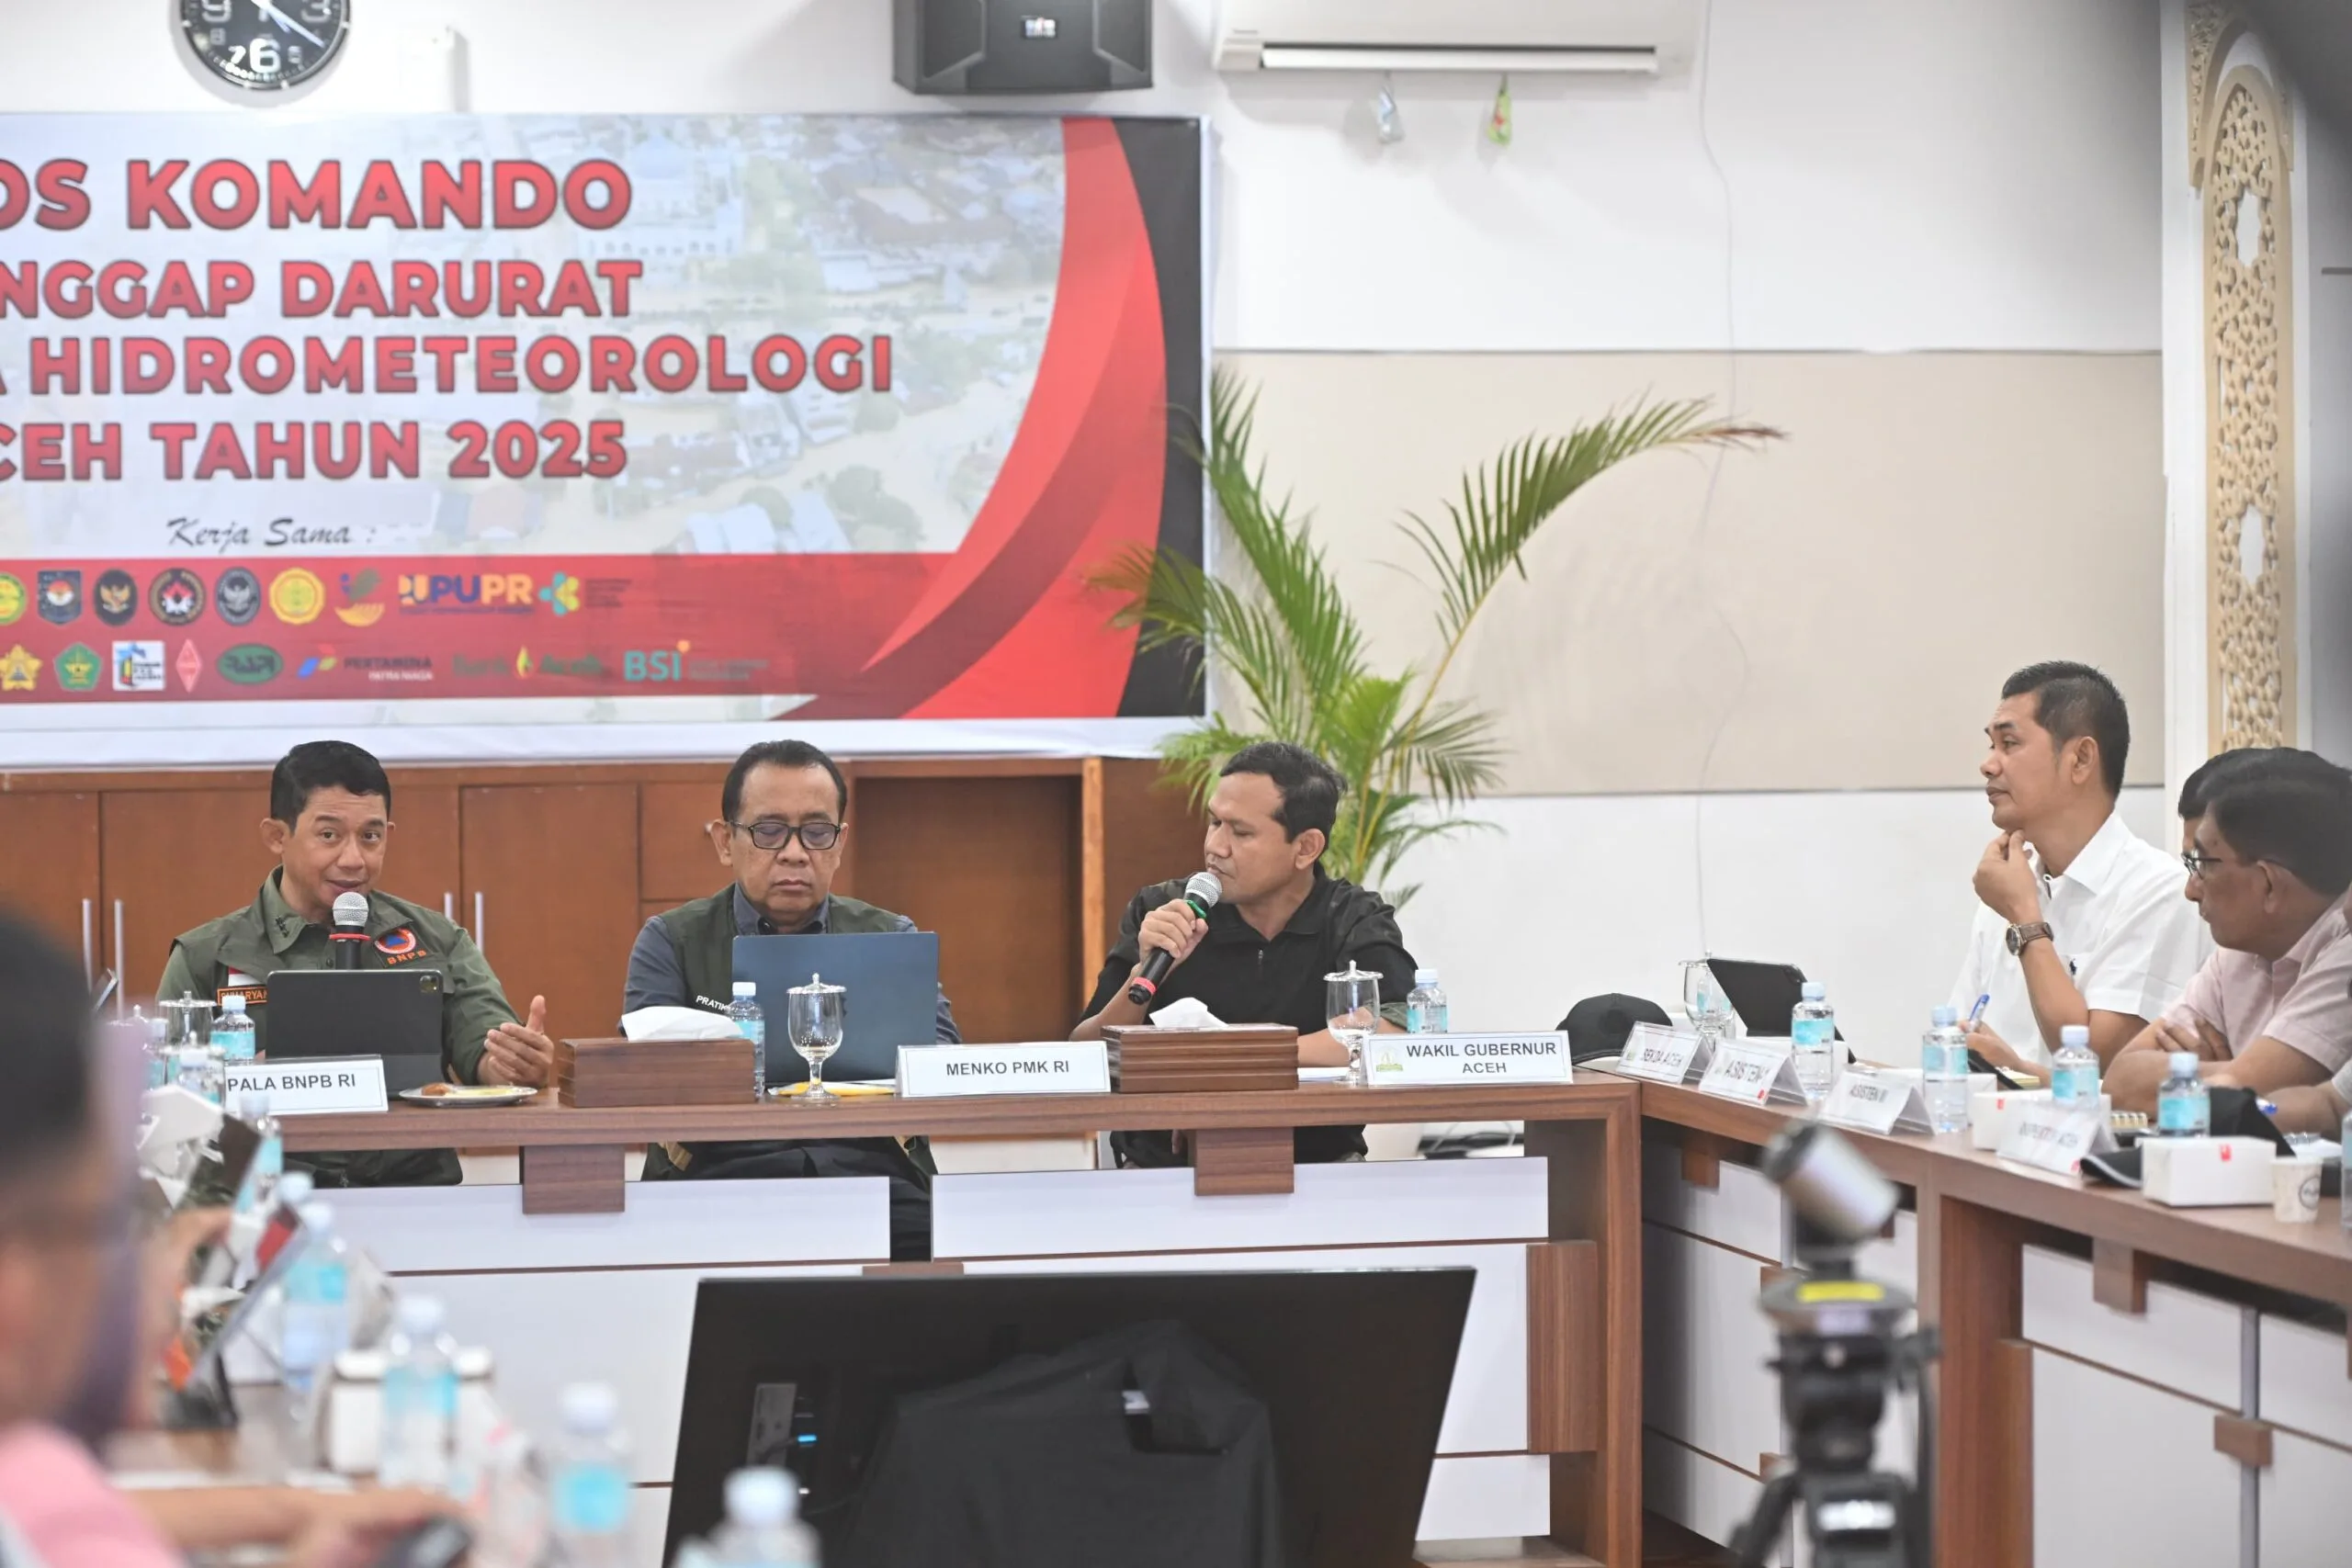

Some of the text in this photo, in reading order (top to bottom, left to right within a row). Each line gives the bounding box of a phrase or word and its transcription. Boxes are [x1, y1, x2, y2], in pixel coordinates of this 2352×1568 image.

[250, 38, 282, 74] 6
[127, 159, 632, 231] KOMANDO
[0, 260, 643, 319] NGGAP DARURAT
[29, 334, 891, 396] HIDROMETEOROLOGI
[150, 421, 419, 479] TAHUN
[447, 420, 628, 479] 2025
[166, 516, 250, 554] Kerja
[264, 517, 350, 547] Sama
[624, 645, 685, 682] BSI
[387, 949, 427, 964] BNPB
[946, 1060, 1069, 1076] MENKO PMK RI
[1406, 1042, 1556, 1058] WAKIL GUBERNUR
[1462, 1062, 1507, 1074] ACEH
[282, 1075, 332, 1089] BNPB
[338, 1074, 356, 1088] RI
